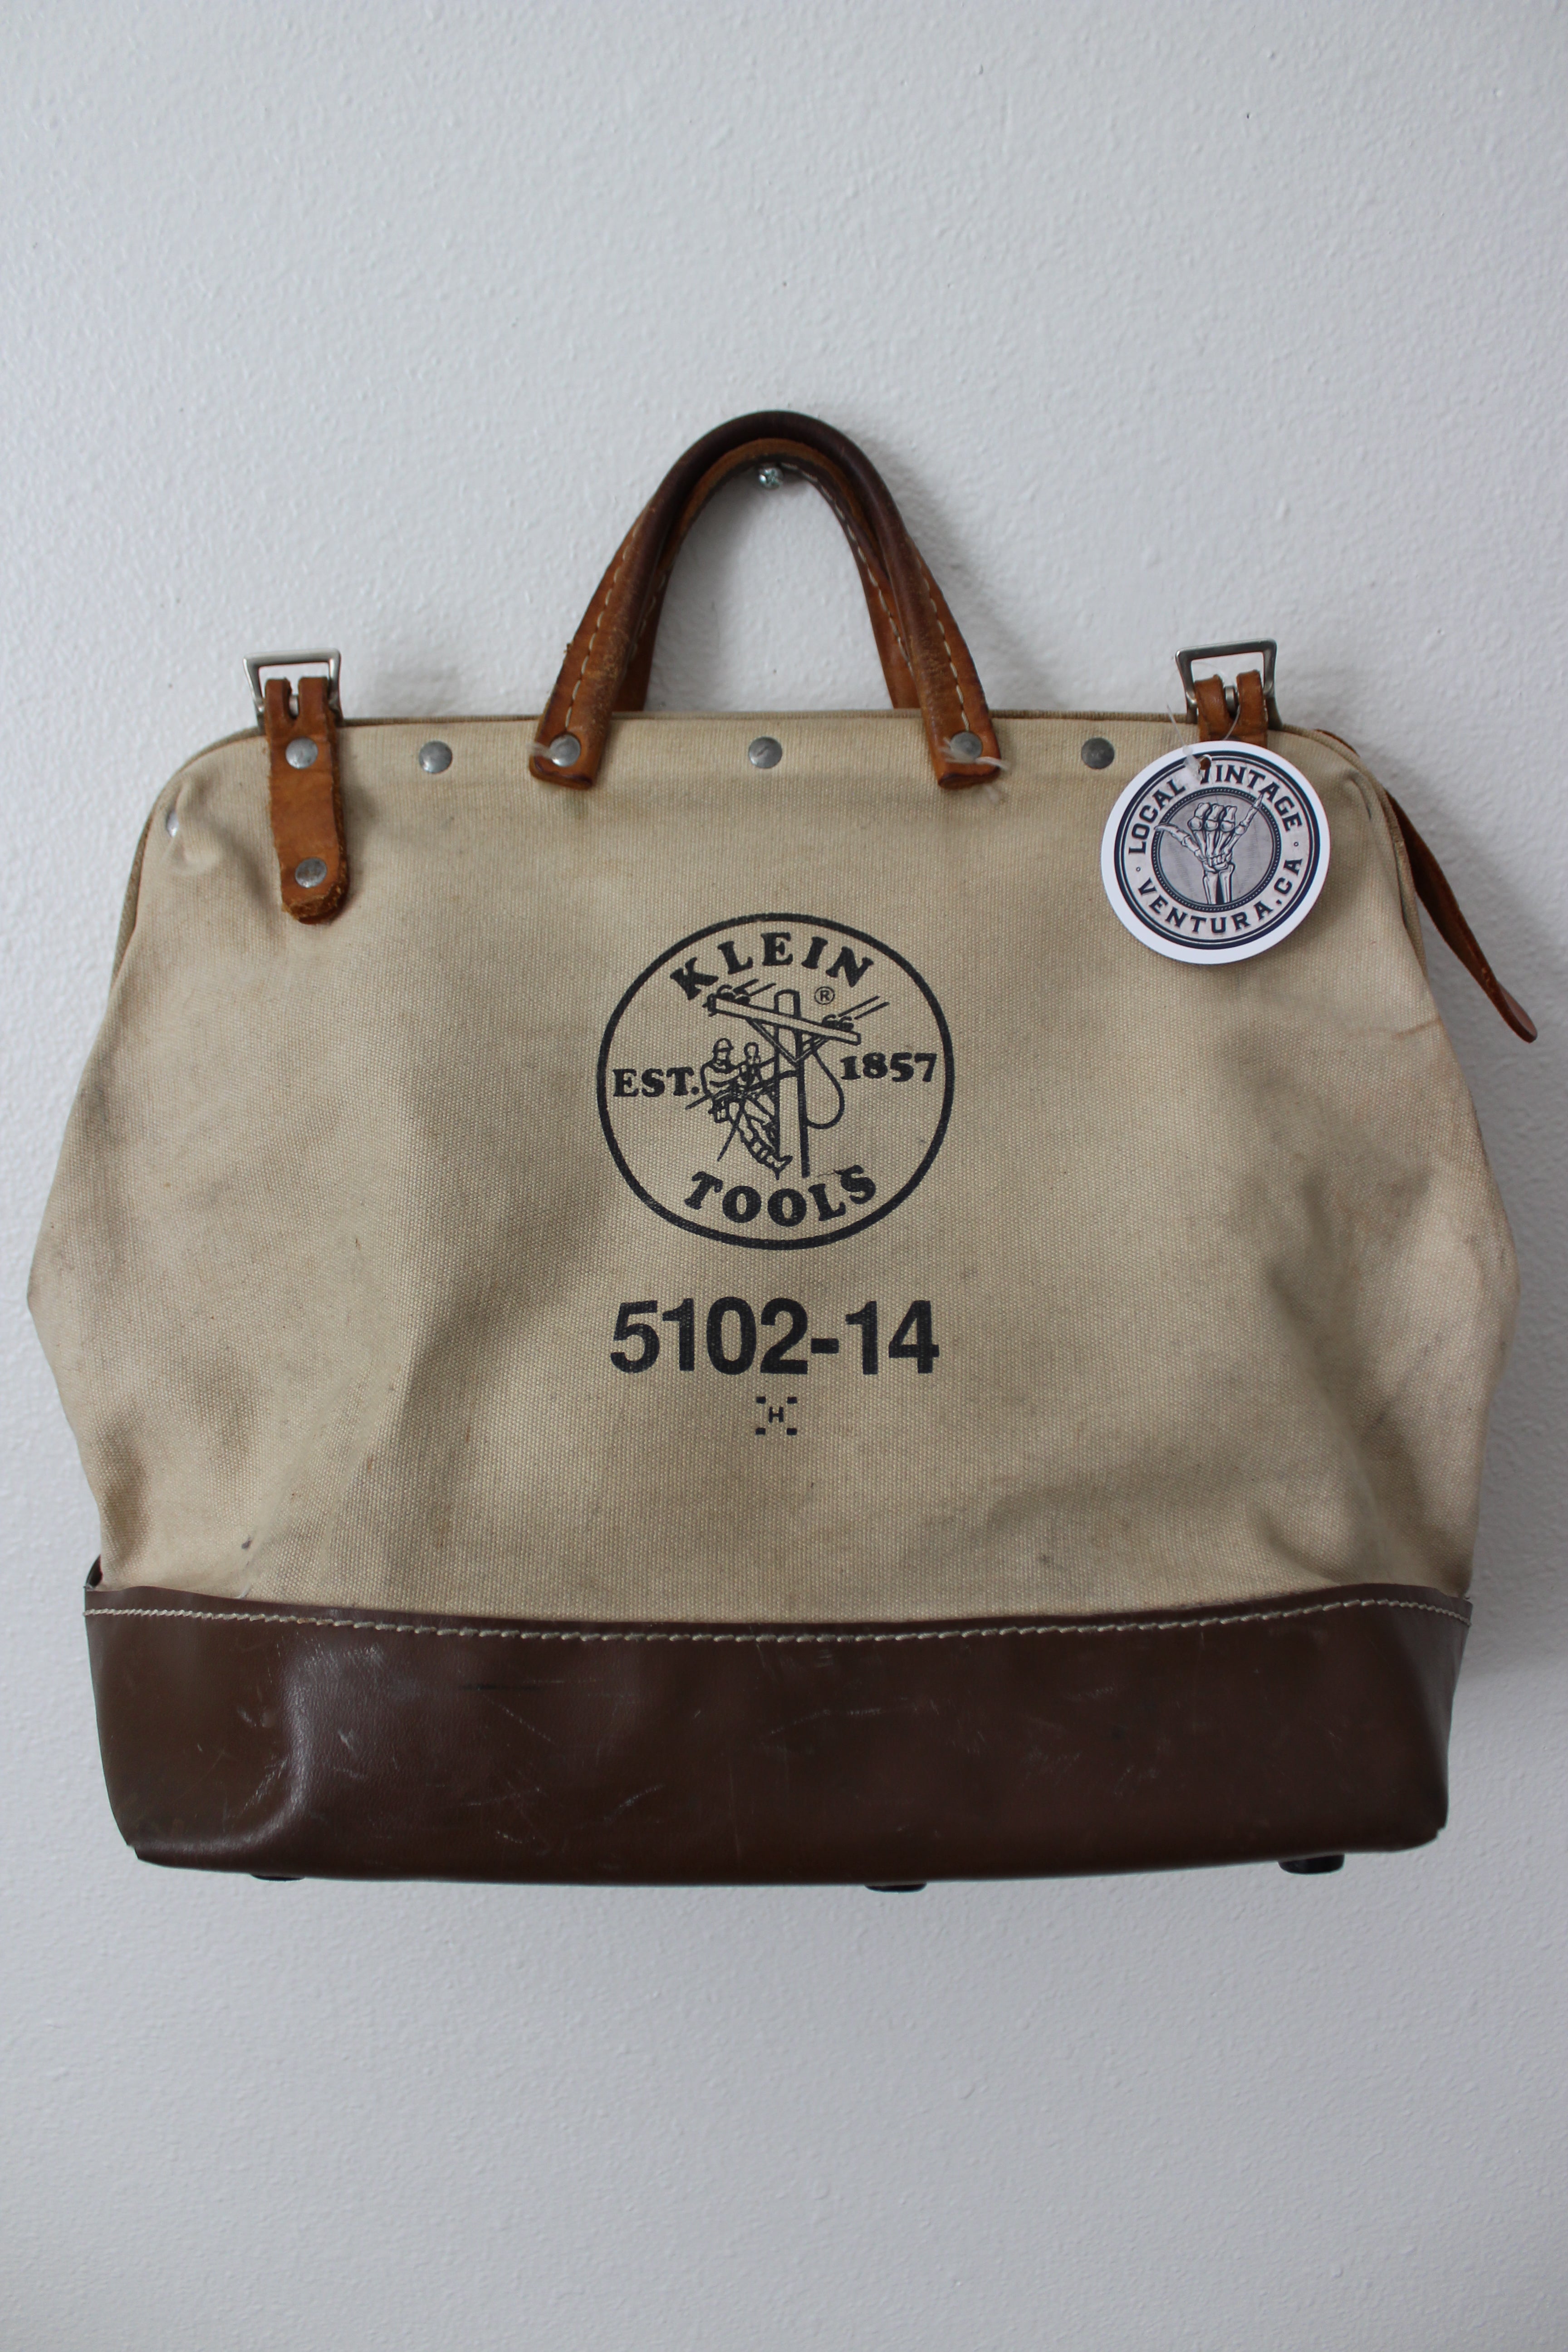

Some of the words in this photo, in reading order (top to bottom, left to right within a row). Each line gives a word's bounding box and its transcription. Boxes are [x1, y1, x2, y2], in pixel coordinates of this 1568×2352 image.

[1128, 779, 1186, 855] LOCAL
[670, 931, 874, 1000] KLEIN
[612, 1066, 700, 1097] EST.
[840, 1053, 937, 1083] 1857
[684, 1165, 877, 1227] TOOLS
[610, 1296, 940, 1375] 5102-14
